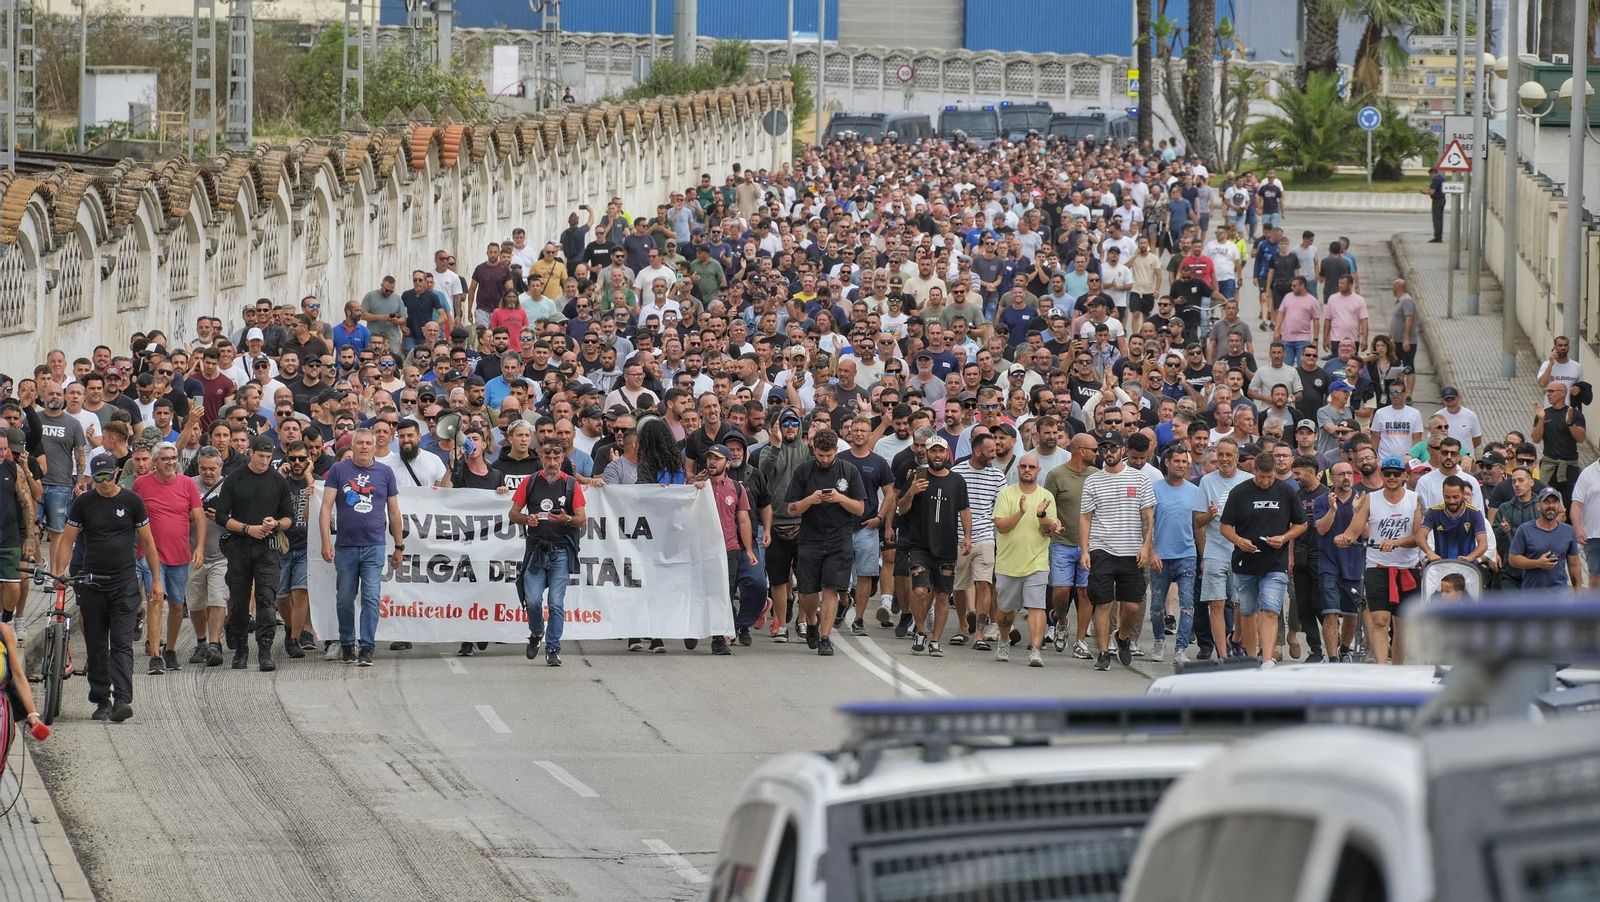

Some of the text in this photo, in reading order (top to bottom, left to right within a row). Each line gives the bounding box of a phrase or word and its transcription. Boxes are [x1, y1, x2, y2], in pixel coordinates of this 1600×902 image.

[1077, 386, 1097, 397] VAN
[41, 424, 66, 438] ANS
[618, 516, 653, 540] LA
[1377, 516, 1410, 532] NEVER
[379, 595, 463, 619] Sindicato
[468, 602, 489, 621] de
